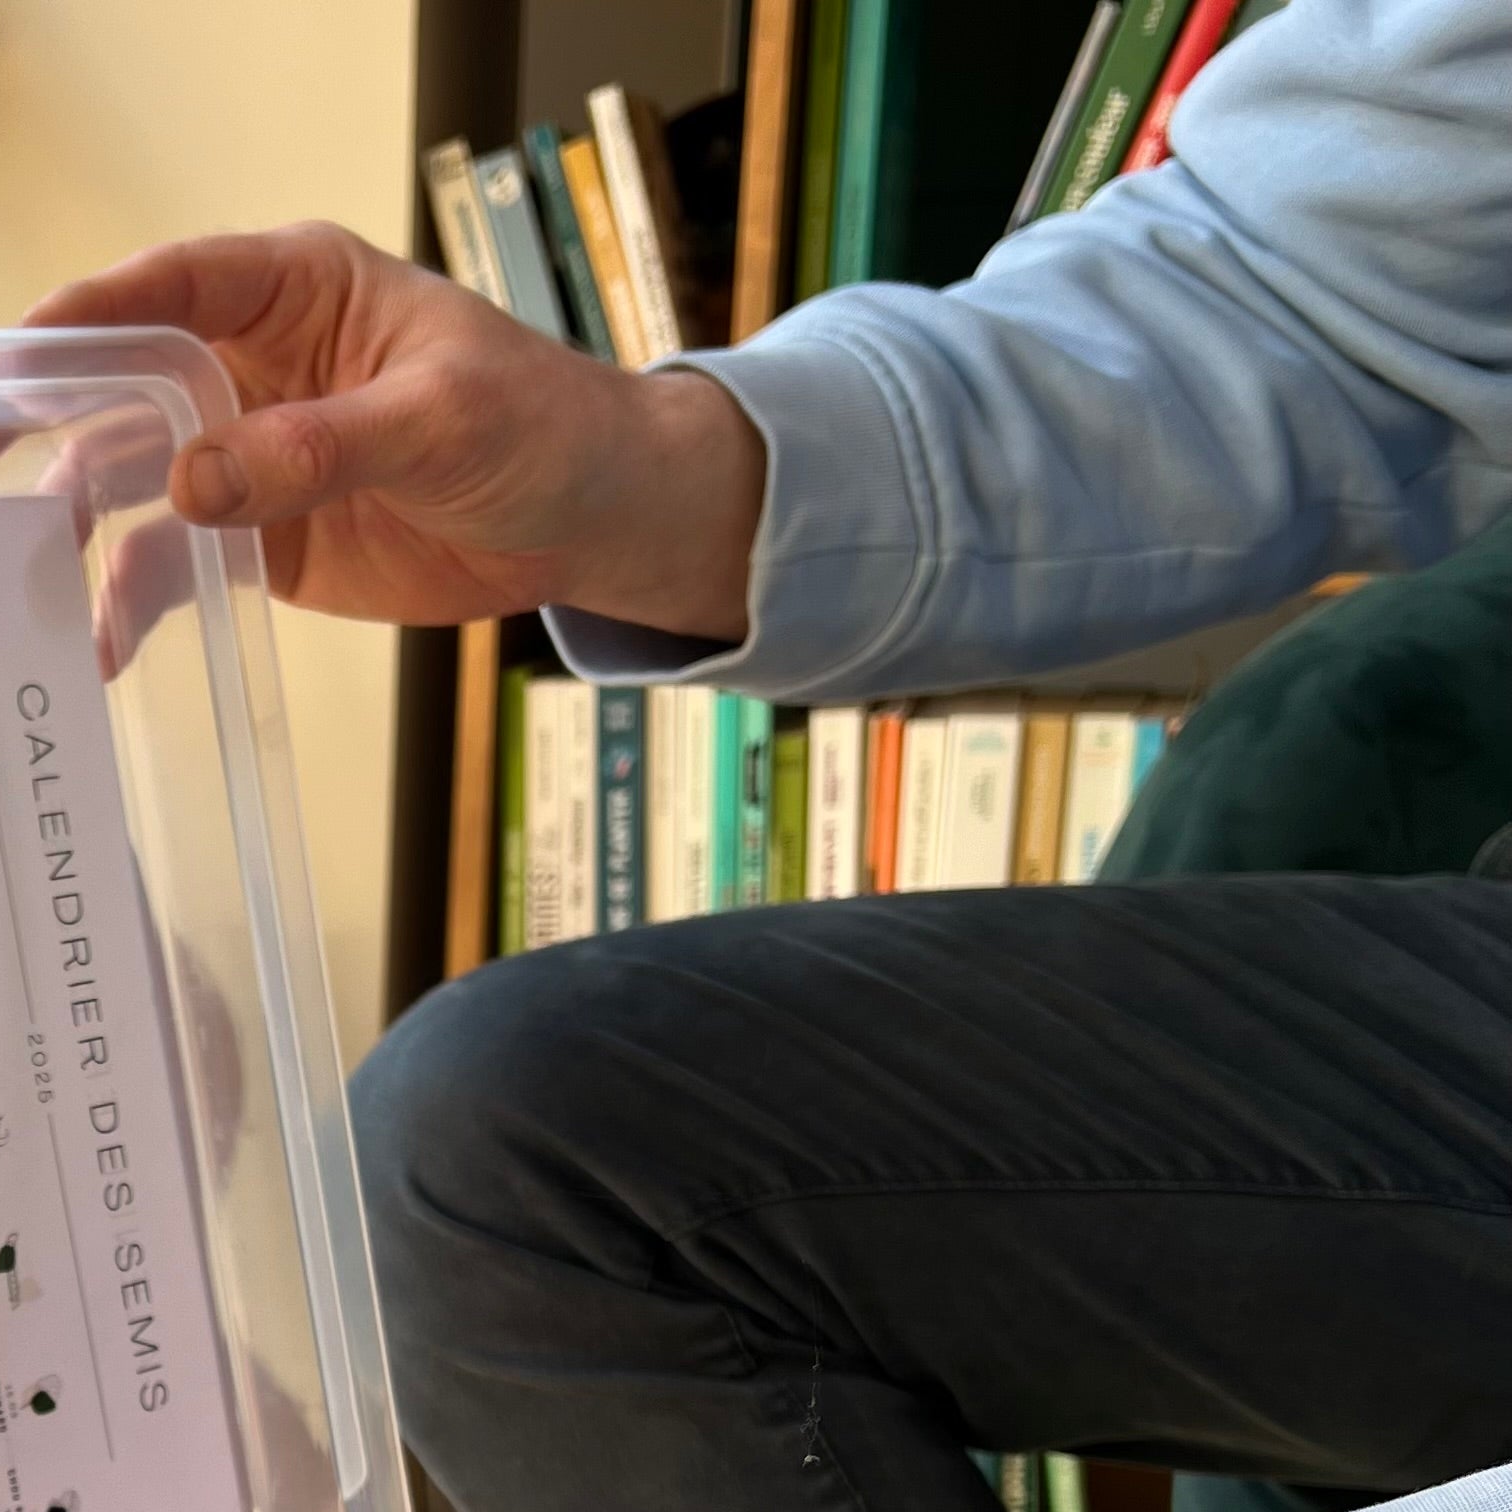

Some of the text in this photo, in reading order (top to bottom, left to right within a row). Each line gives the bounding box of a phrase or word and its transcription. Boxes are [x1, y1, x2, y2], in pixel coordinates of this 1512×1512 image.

[16, 682, 169, 1412] CALENDRIER DES SEMIS
[25, 1030, 55, 1106] 2025
